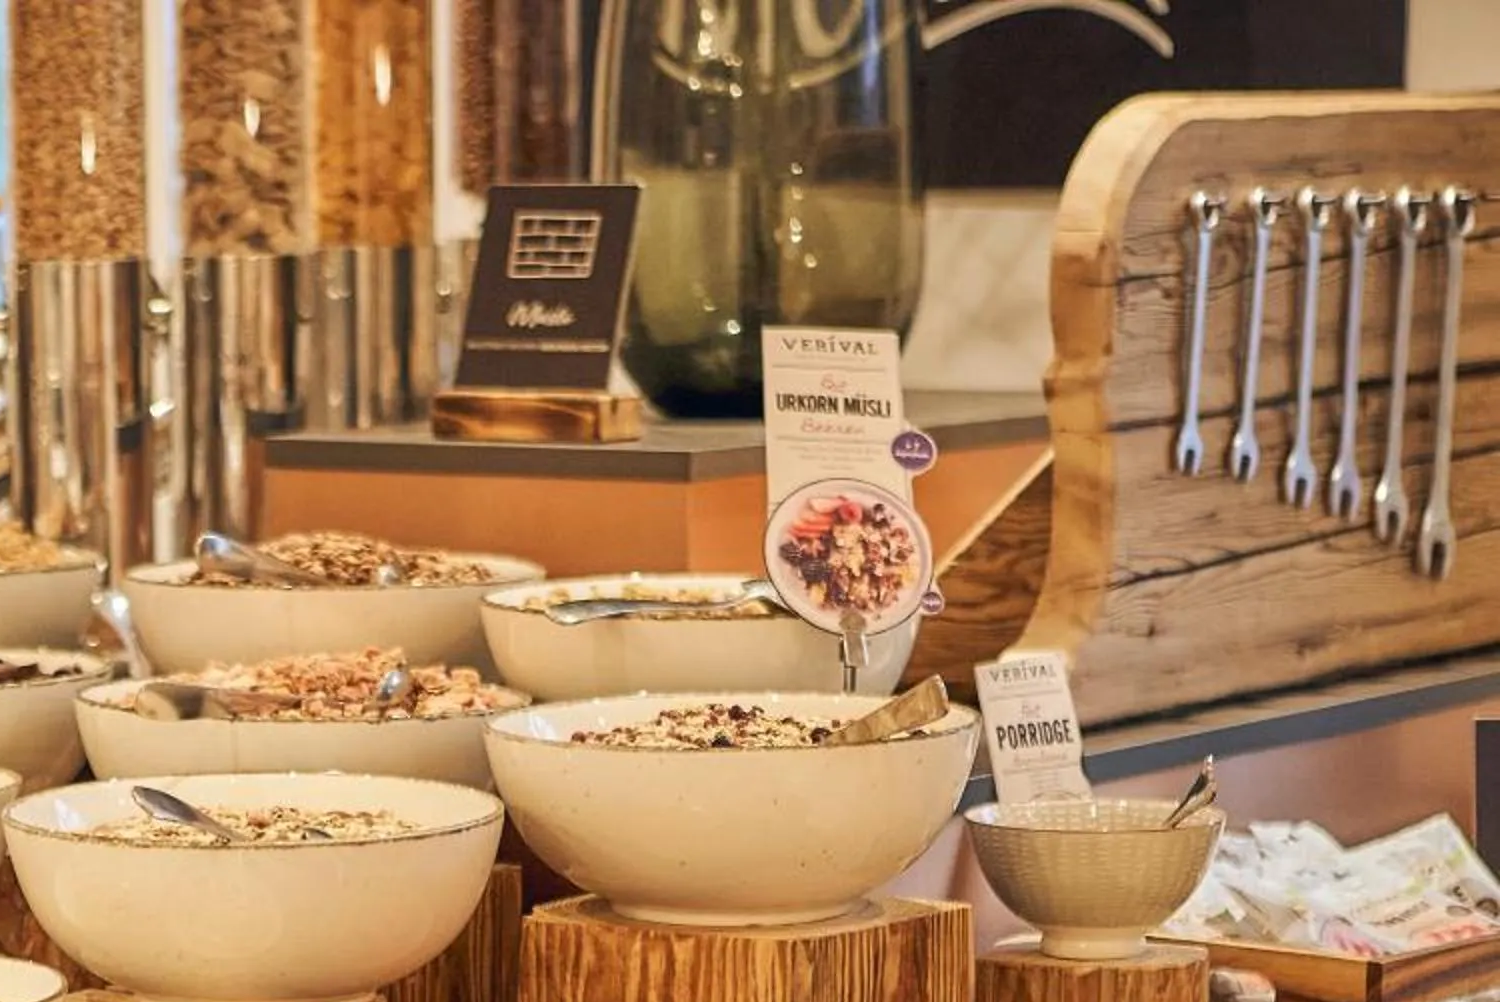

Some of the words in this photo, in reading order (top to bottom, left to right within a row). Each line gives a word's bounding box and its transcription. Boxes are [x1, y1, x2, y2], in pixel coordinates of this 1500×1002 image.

[775, 393, 838, 415] URKORN
[844, 393, 891, 418] MÜSLI
[996, 719, 1075, 750] PORRIDGE
